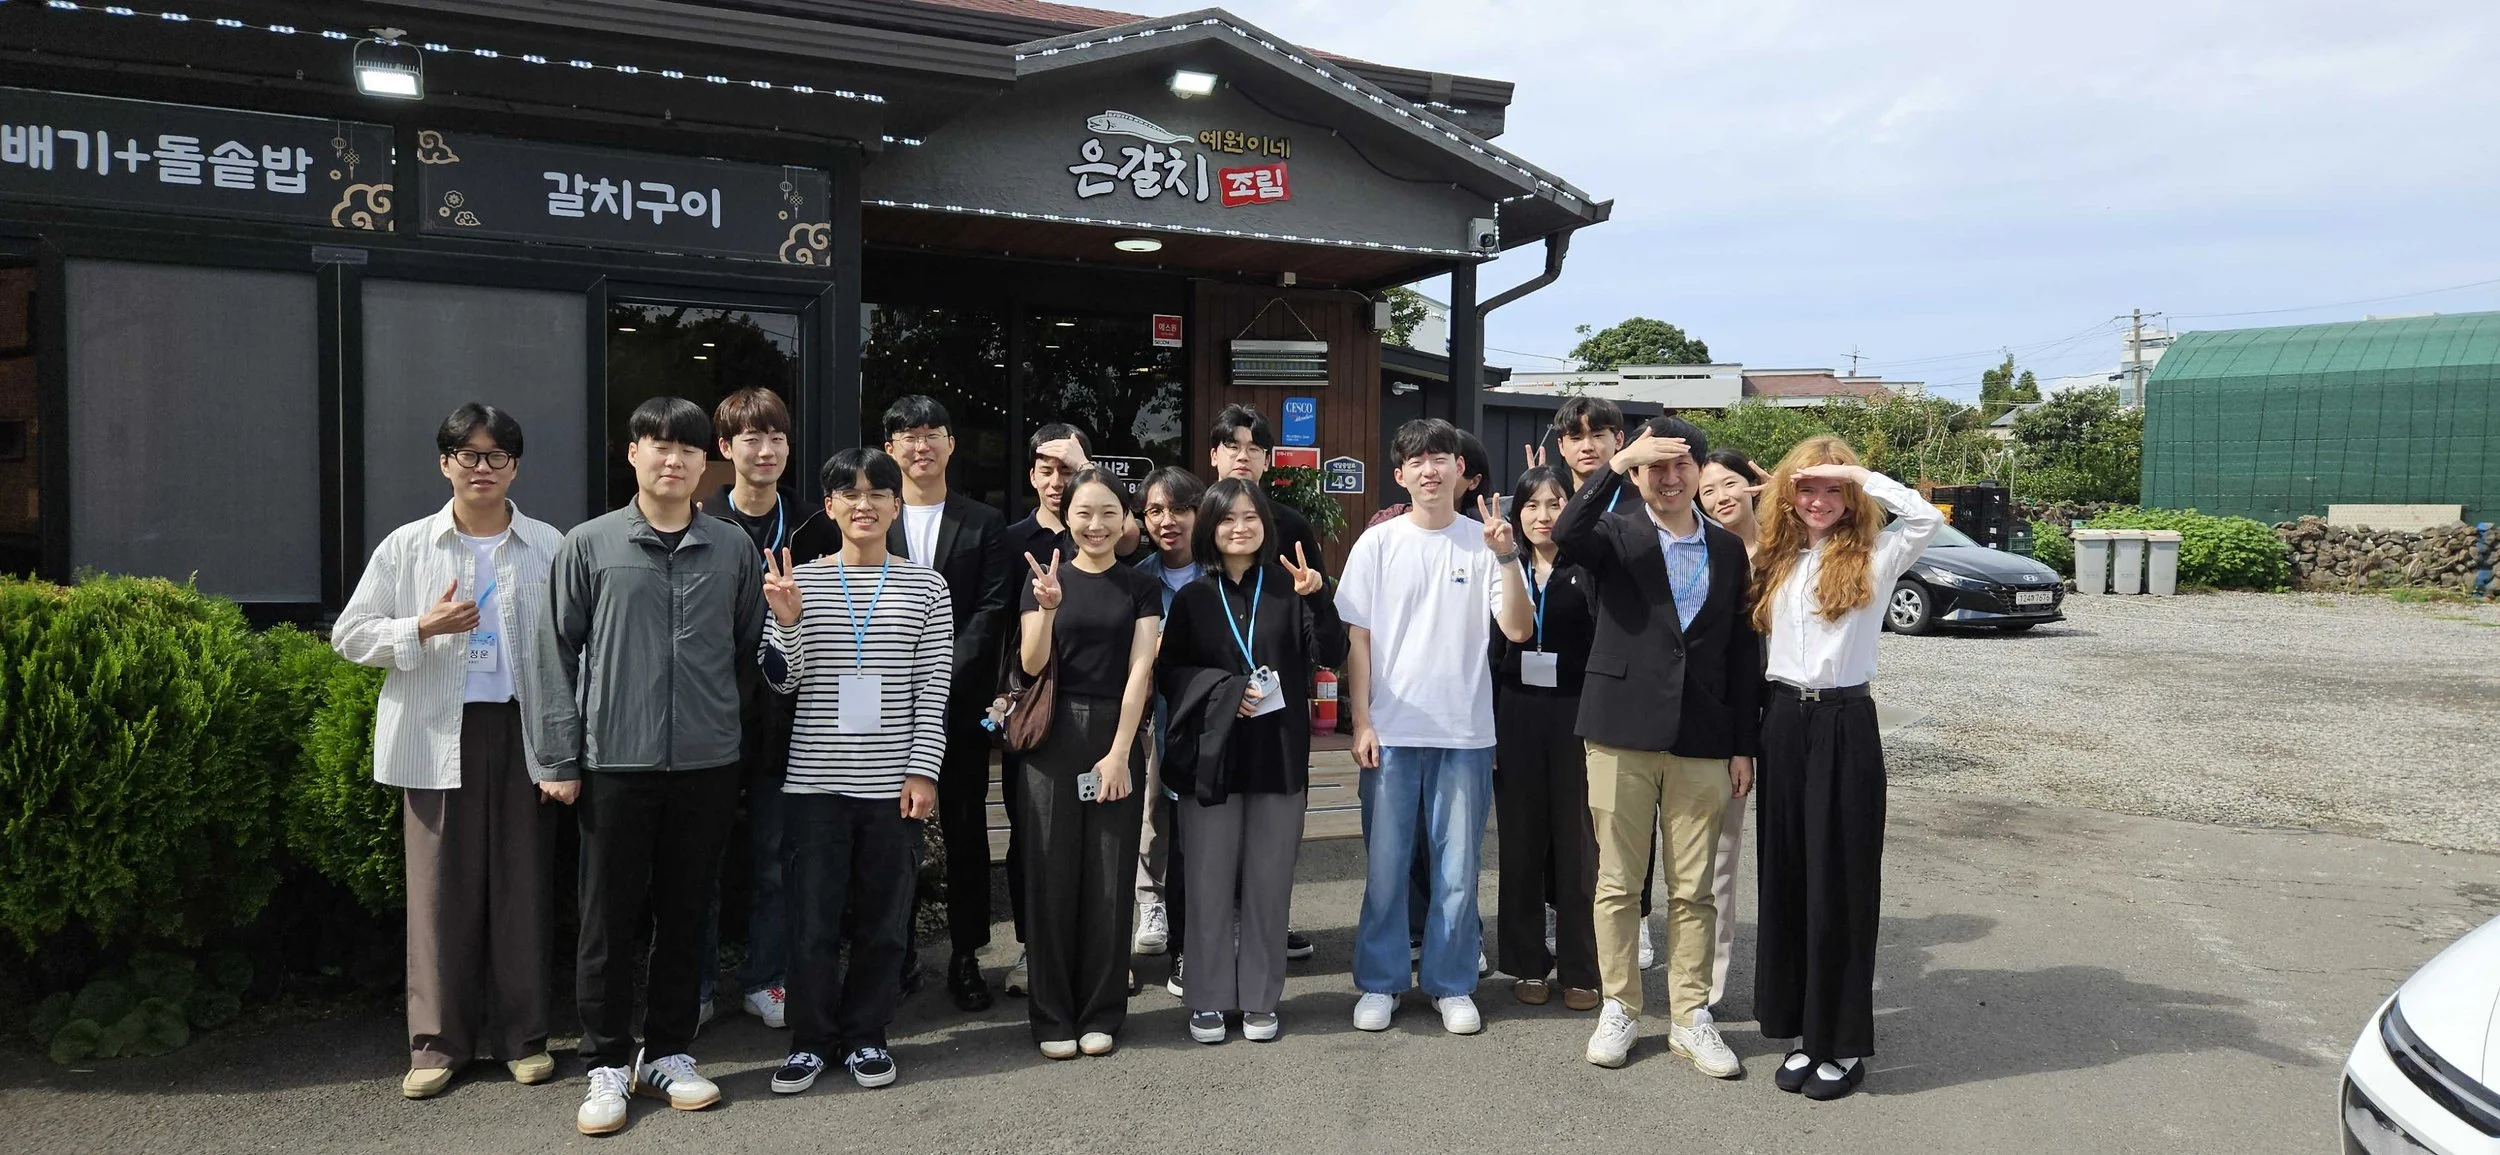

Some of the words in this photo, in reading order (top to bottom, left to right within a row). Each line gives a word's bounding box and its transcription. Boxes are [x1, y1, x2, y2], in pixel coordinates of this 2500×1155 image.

[0, 124, 314, 194] 배기+돌솥밥
[1199, 130, 1291, 158] 예원이네
[1068, 137, 1211, 202] 은갈치
[1226, 169, 1284, 199] 조림
[543, 171, 721, 229] 갈치구이
[1285, 402, 1313, 414] CESCO
[1331, 475, 1357, 490] 49
